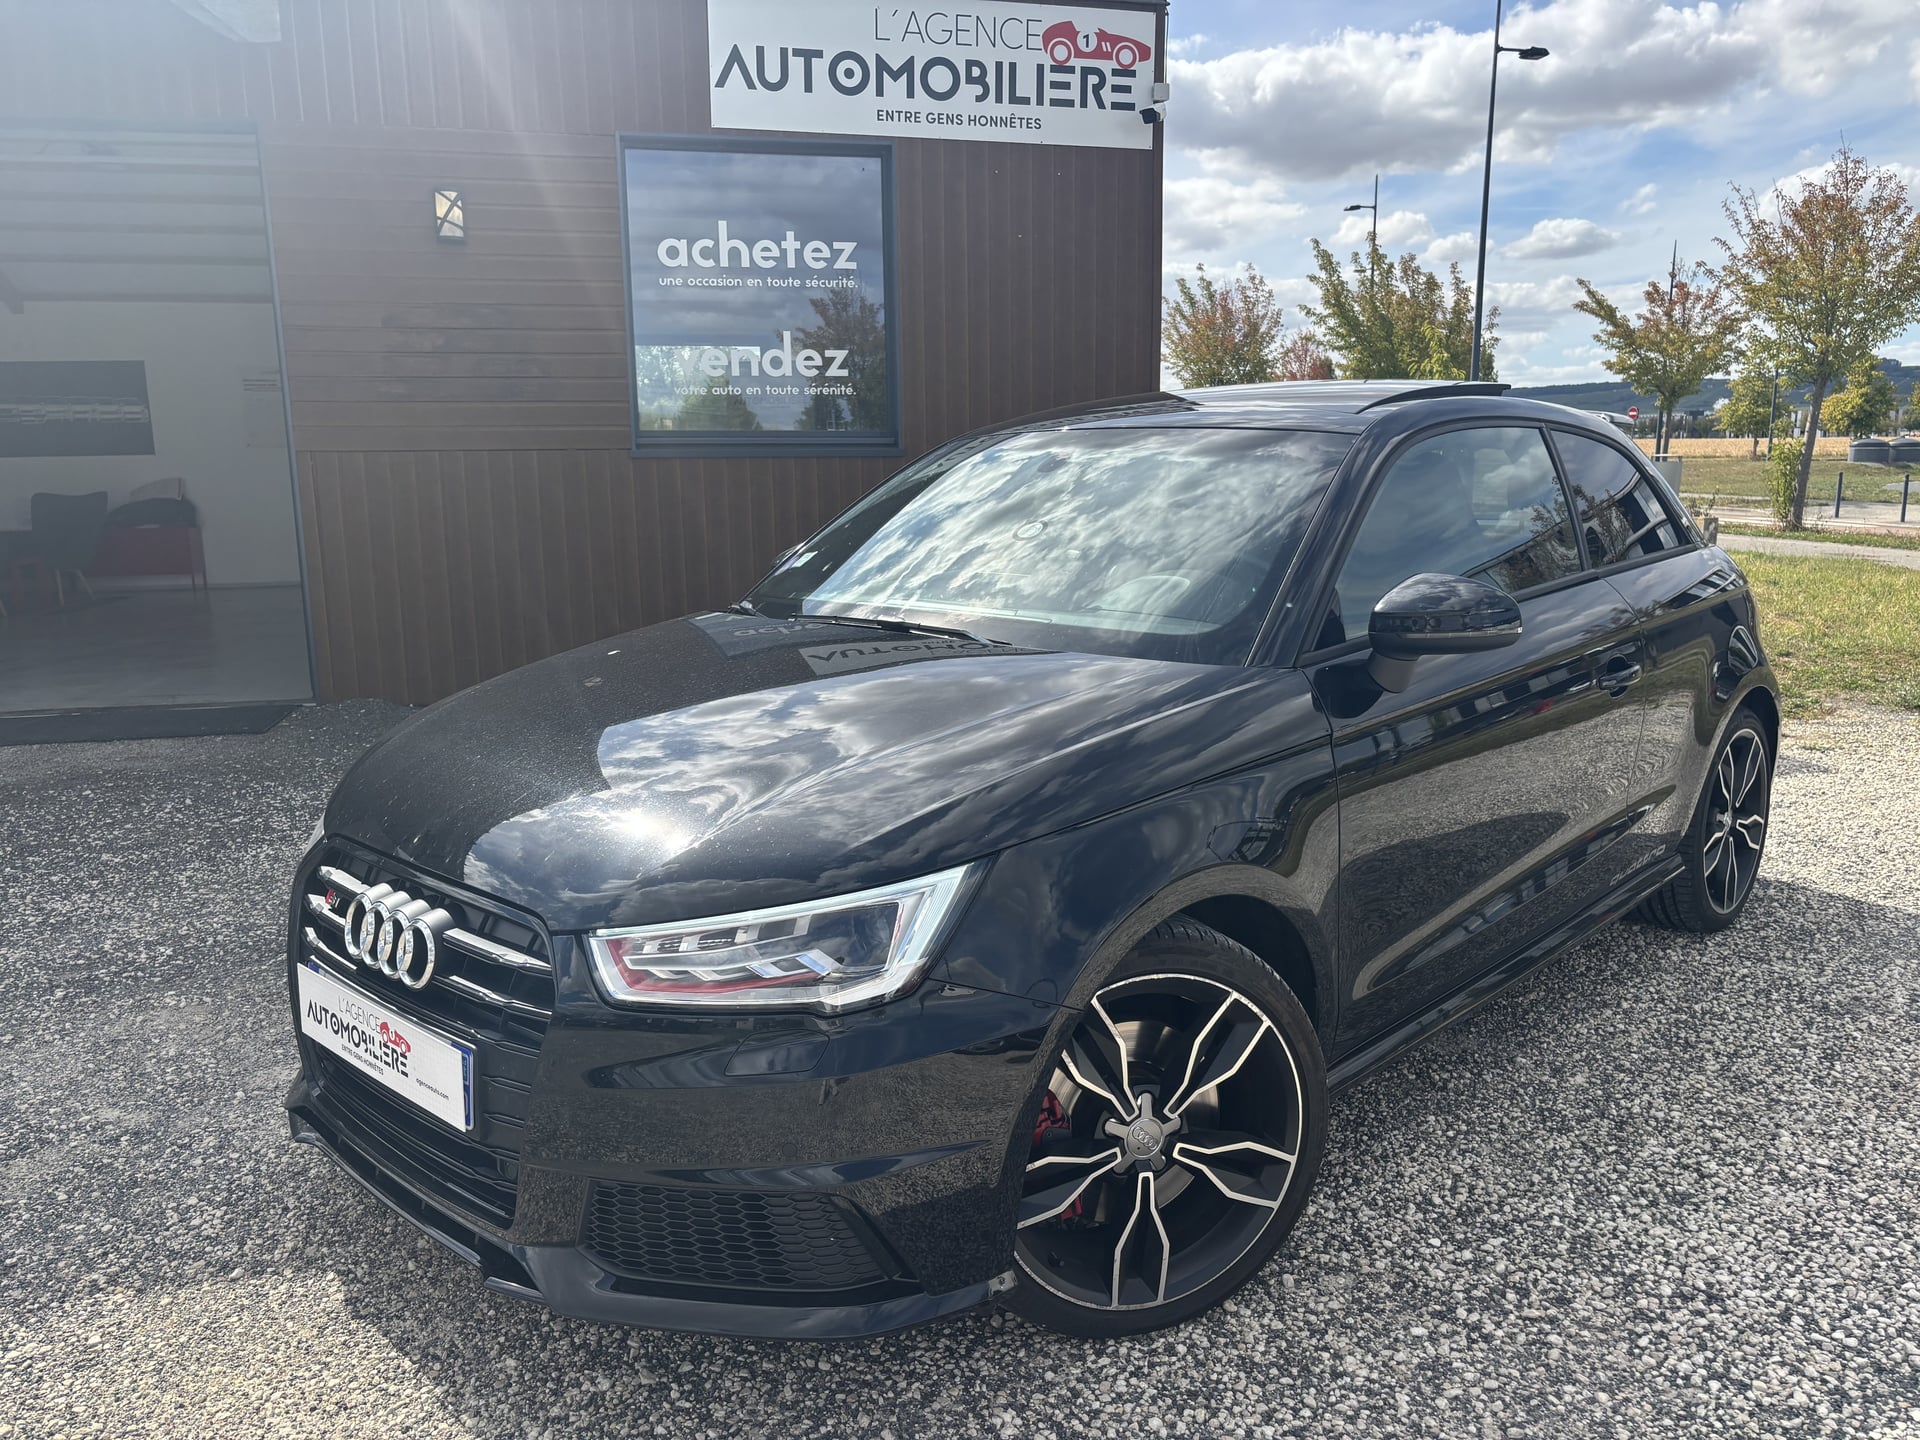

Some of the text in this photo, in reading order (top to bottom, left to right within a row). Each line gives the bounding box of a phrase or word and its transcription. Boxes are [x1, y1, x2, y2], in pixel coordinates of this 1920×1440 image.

[1082, 33, 1090, 49] 1
[876, 109, 1042, 130] ENTRE GENS HONNÊTES
[657, 220, 857, 270] achetez
[658, 274, 858, 288] une occasion en toute sécurité.
[674, 330, 849, 377] vendez
[674, 382, 857, 396] votre auto en toute sérénité.
[1609, 843, 1667, 886] quattro
